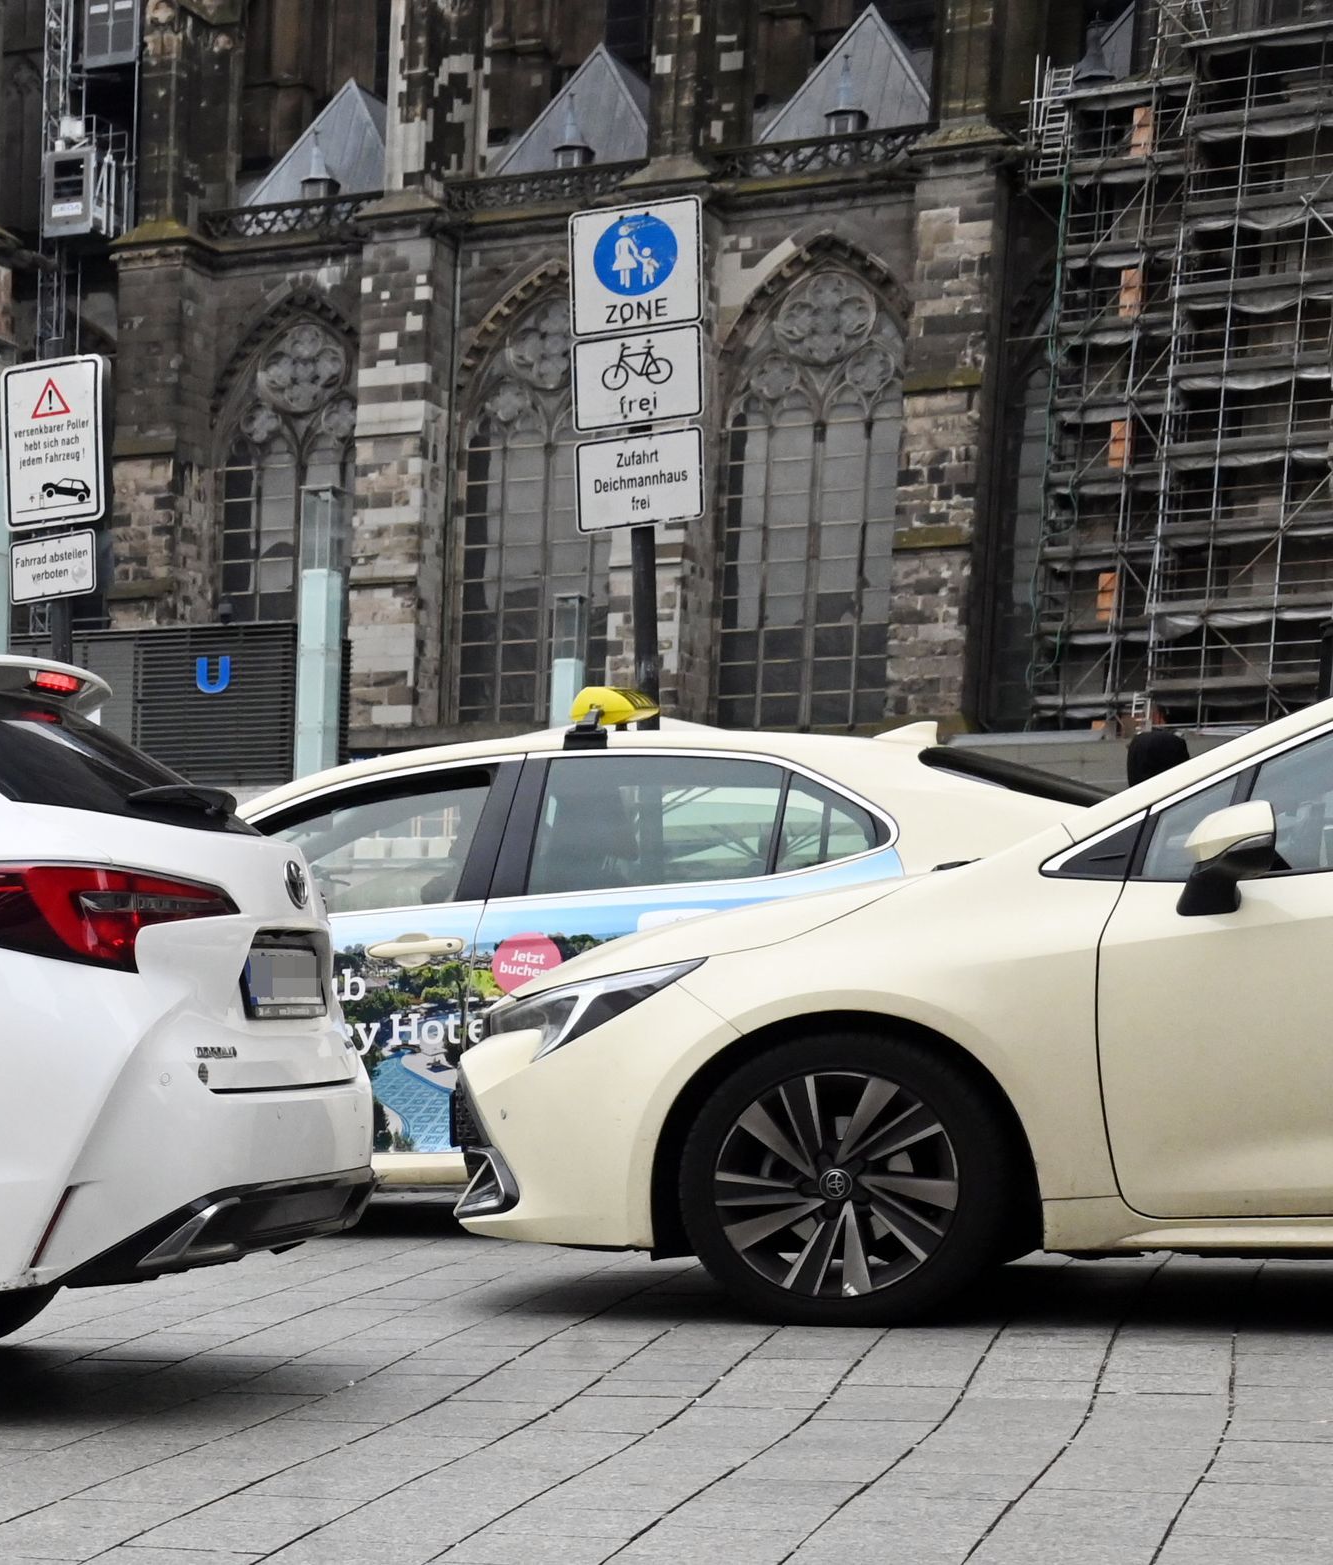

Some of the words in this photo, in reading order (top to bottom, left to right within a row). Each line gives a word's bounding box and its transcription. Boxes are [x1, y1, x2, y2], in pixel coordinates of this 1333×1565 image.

[605, 297, 668, 324] ZONE
[619, 391, 658, 414] frei
[13, 423, 64, 439] versenkbarer
[66, 418, 89, 431] Poller
[24, 440, 41, 452] hebt
[43, 437, 59, 449] sich
[61, 433, 80, 447] nach
[19, 456, 43, 470] jedem
[616, 448, 659, 468] Zufahrt
[593, 469, 688, 494] Deichmannhaus
[631, 494, 651, 511] frei
[15, 552, 47, 569] Fahrrad
[31, 568, 69, 582] verboten
[196, 655, 230, 694] U
[511, 949, 546, 965] Jetzt
